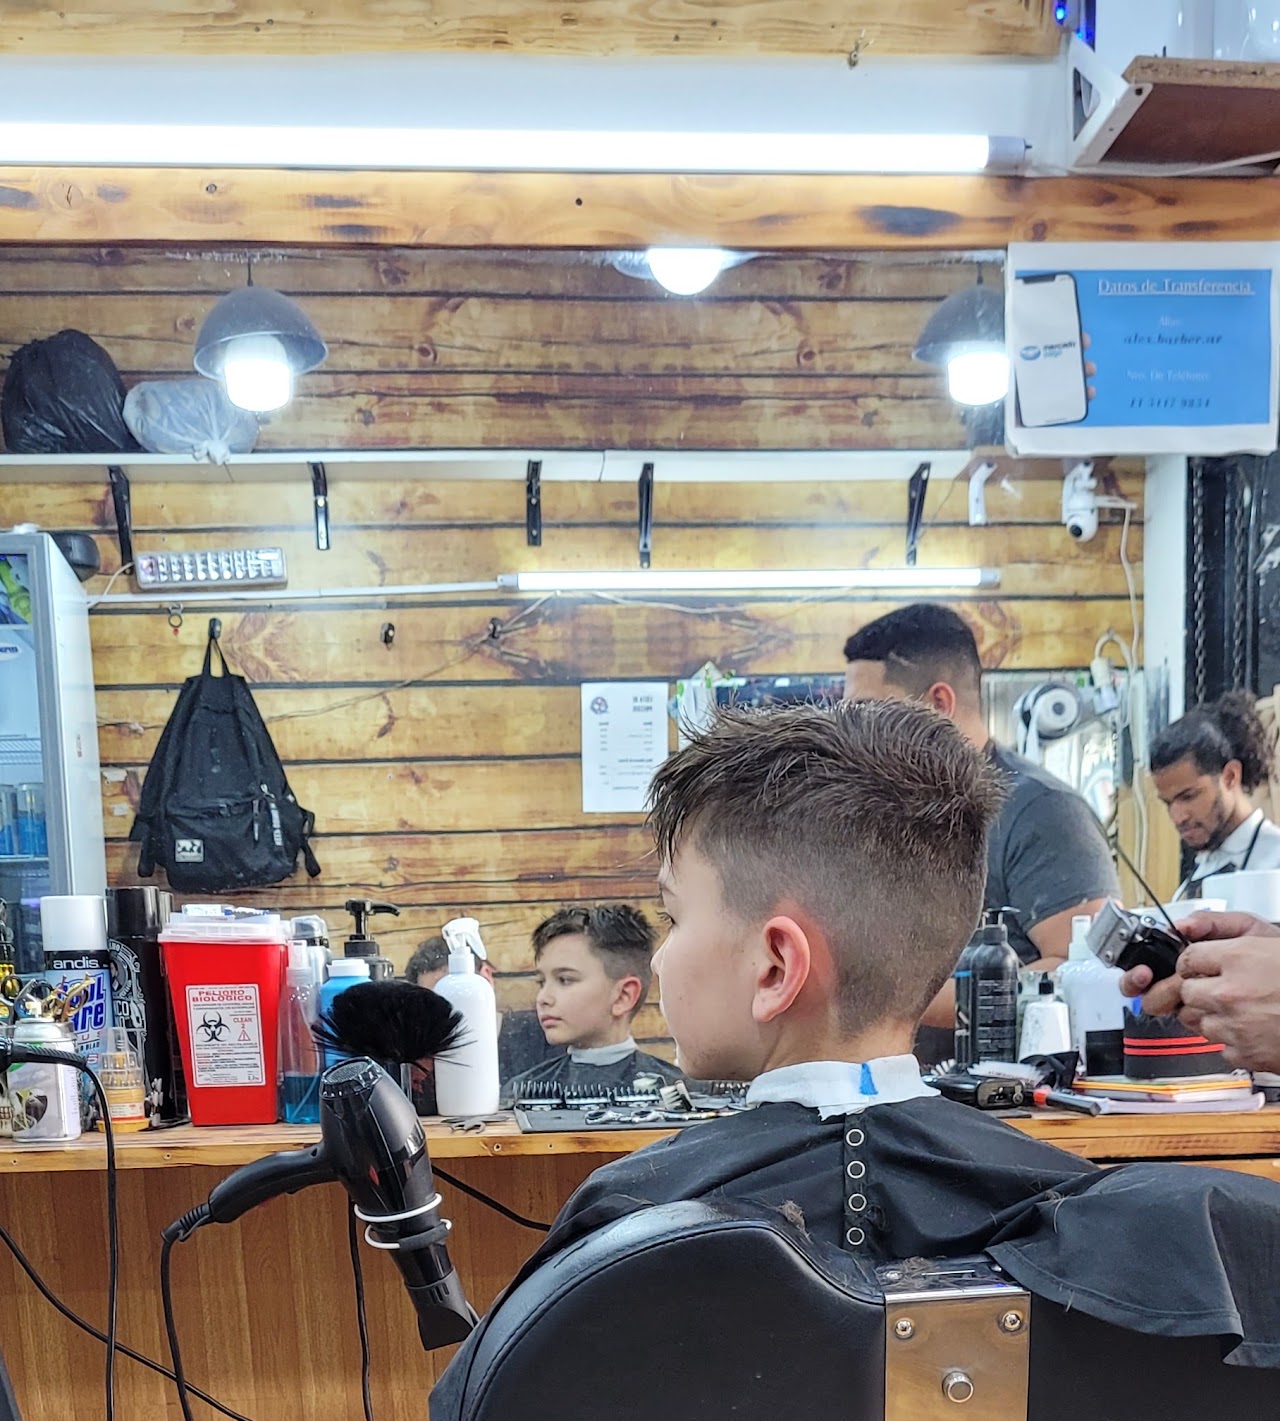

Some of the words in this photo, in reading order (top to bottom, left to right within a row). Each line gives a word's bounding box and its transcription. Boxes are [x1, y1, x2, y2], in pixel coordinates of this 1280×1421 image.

[1098, 279, 1138, 294] Datos
[1141, 279, 1158, 293] de
[53, 956, 100, 969] andis
